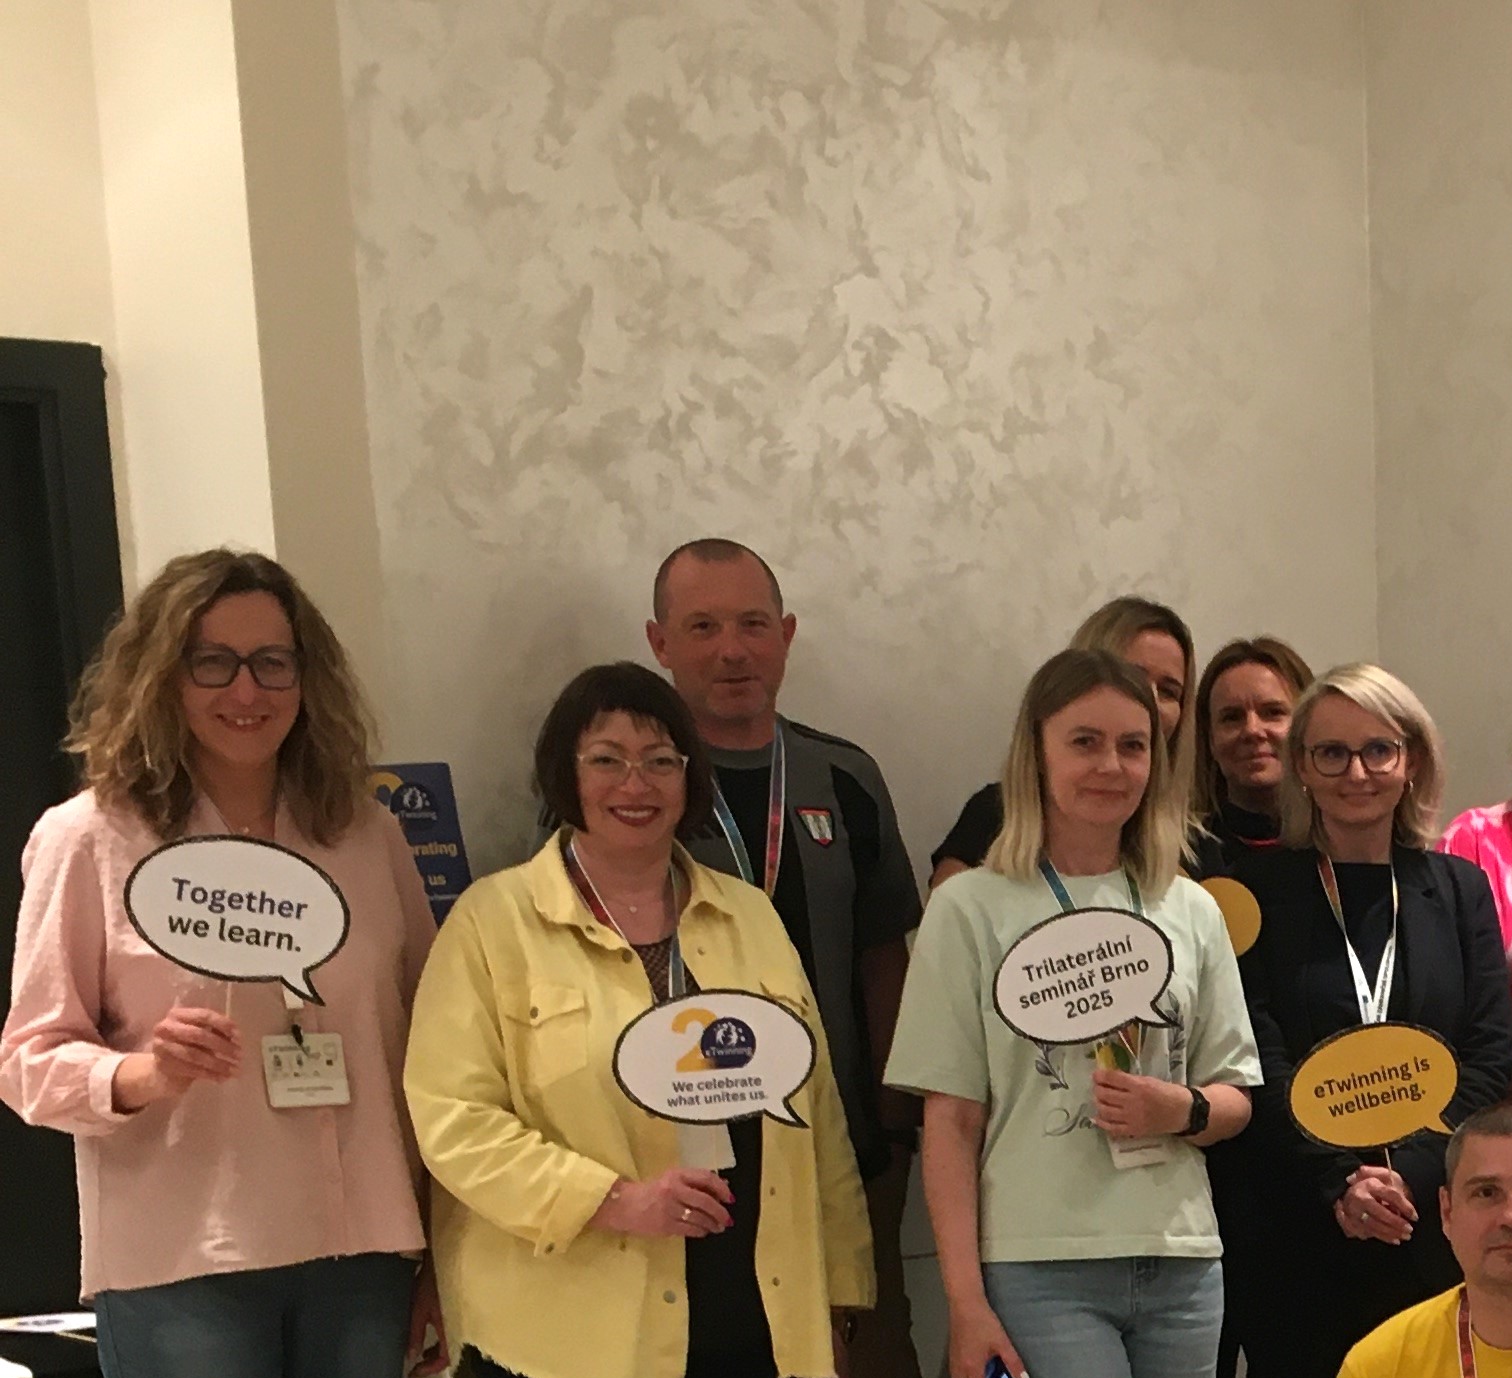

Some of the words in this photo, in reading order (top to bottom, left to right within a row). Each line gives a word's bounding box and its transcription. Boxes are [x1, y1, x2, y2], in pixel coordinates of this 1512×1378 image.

[413, 842, 458, 858] rating
[172, 877, 308, 920] Together
[168, 915, 210, 938] we
[218, 917, 301, 952] learn.
[1022, 935, 1134, 982] Trilaterální
[1019, 969, 1096, 1009] seminář
[1101, 958, 1149, 983] Brno
[1064, 989, 1114, 1019] 2025
[672, 1081, 693, 1093] We
[697, 1077, 762, 1091] celebrate
[1314, 1062, 1412, 1098] eTwinning
[1414, 1056, 1430, 1072] is
[667, 1095, 700, 1107] what
[704, 1091, 746, 1104] unites
[1328, 1083, 1426, 1118] wellbeing.
